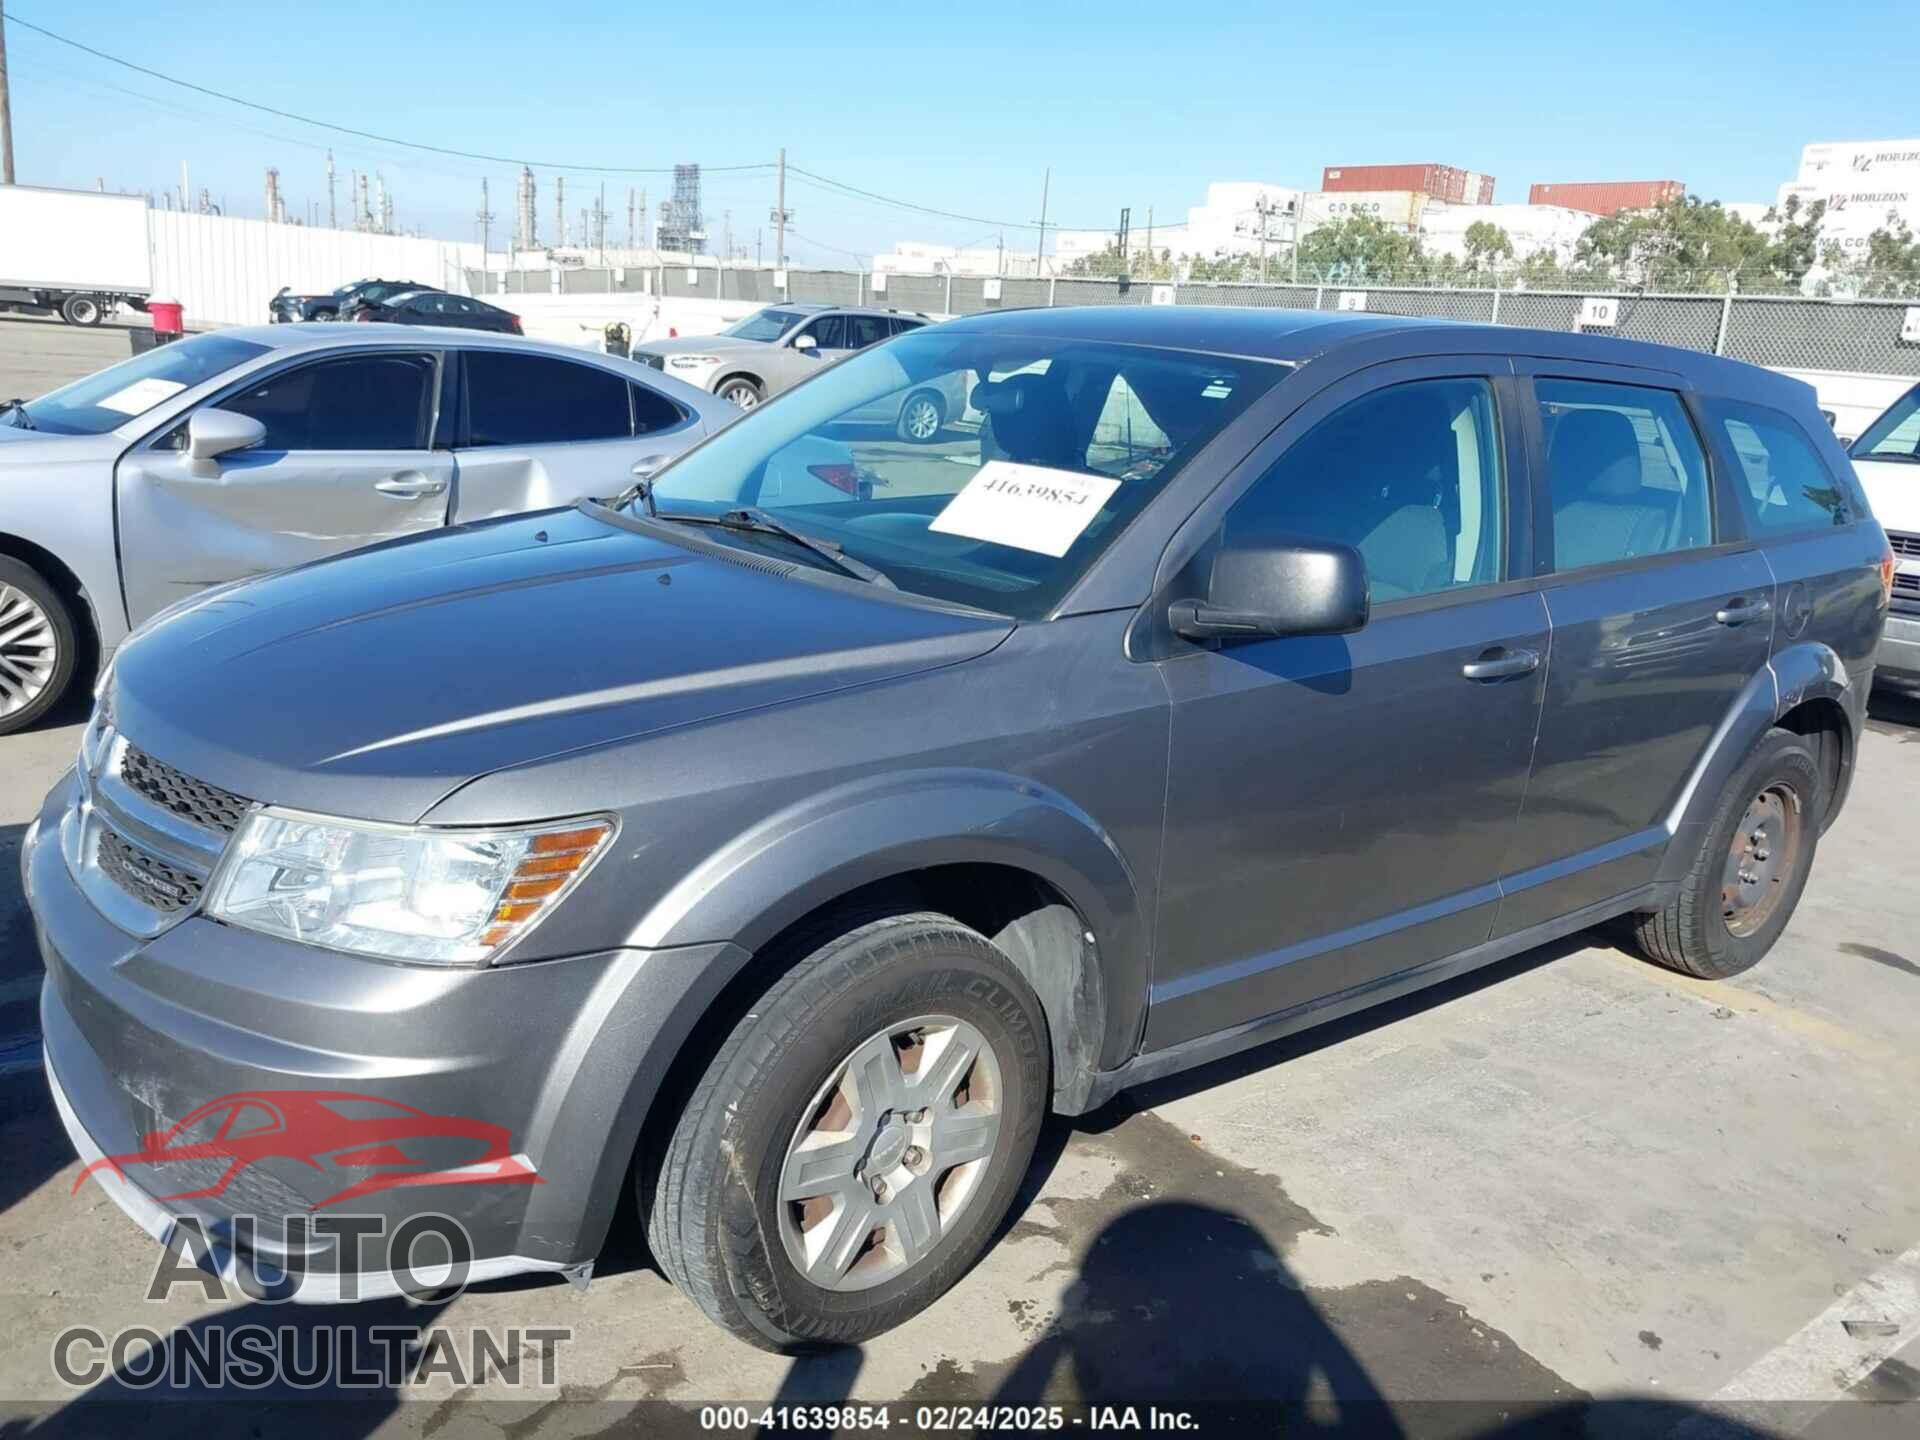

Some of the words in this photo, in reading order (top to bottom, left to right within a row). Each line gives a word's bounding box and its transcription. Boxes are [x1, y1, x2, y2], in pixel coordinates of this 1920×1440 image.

[1850, 193, 1908, 203] HORIZON
[1591, 304, 1609, 320] 10
[983, 479, 1089, 505] 41639854
